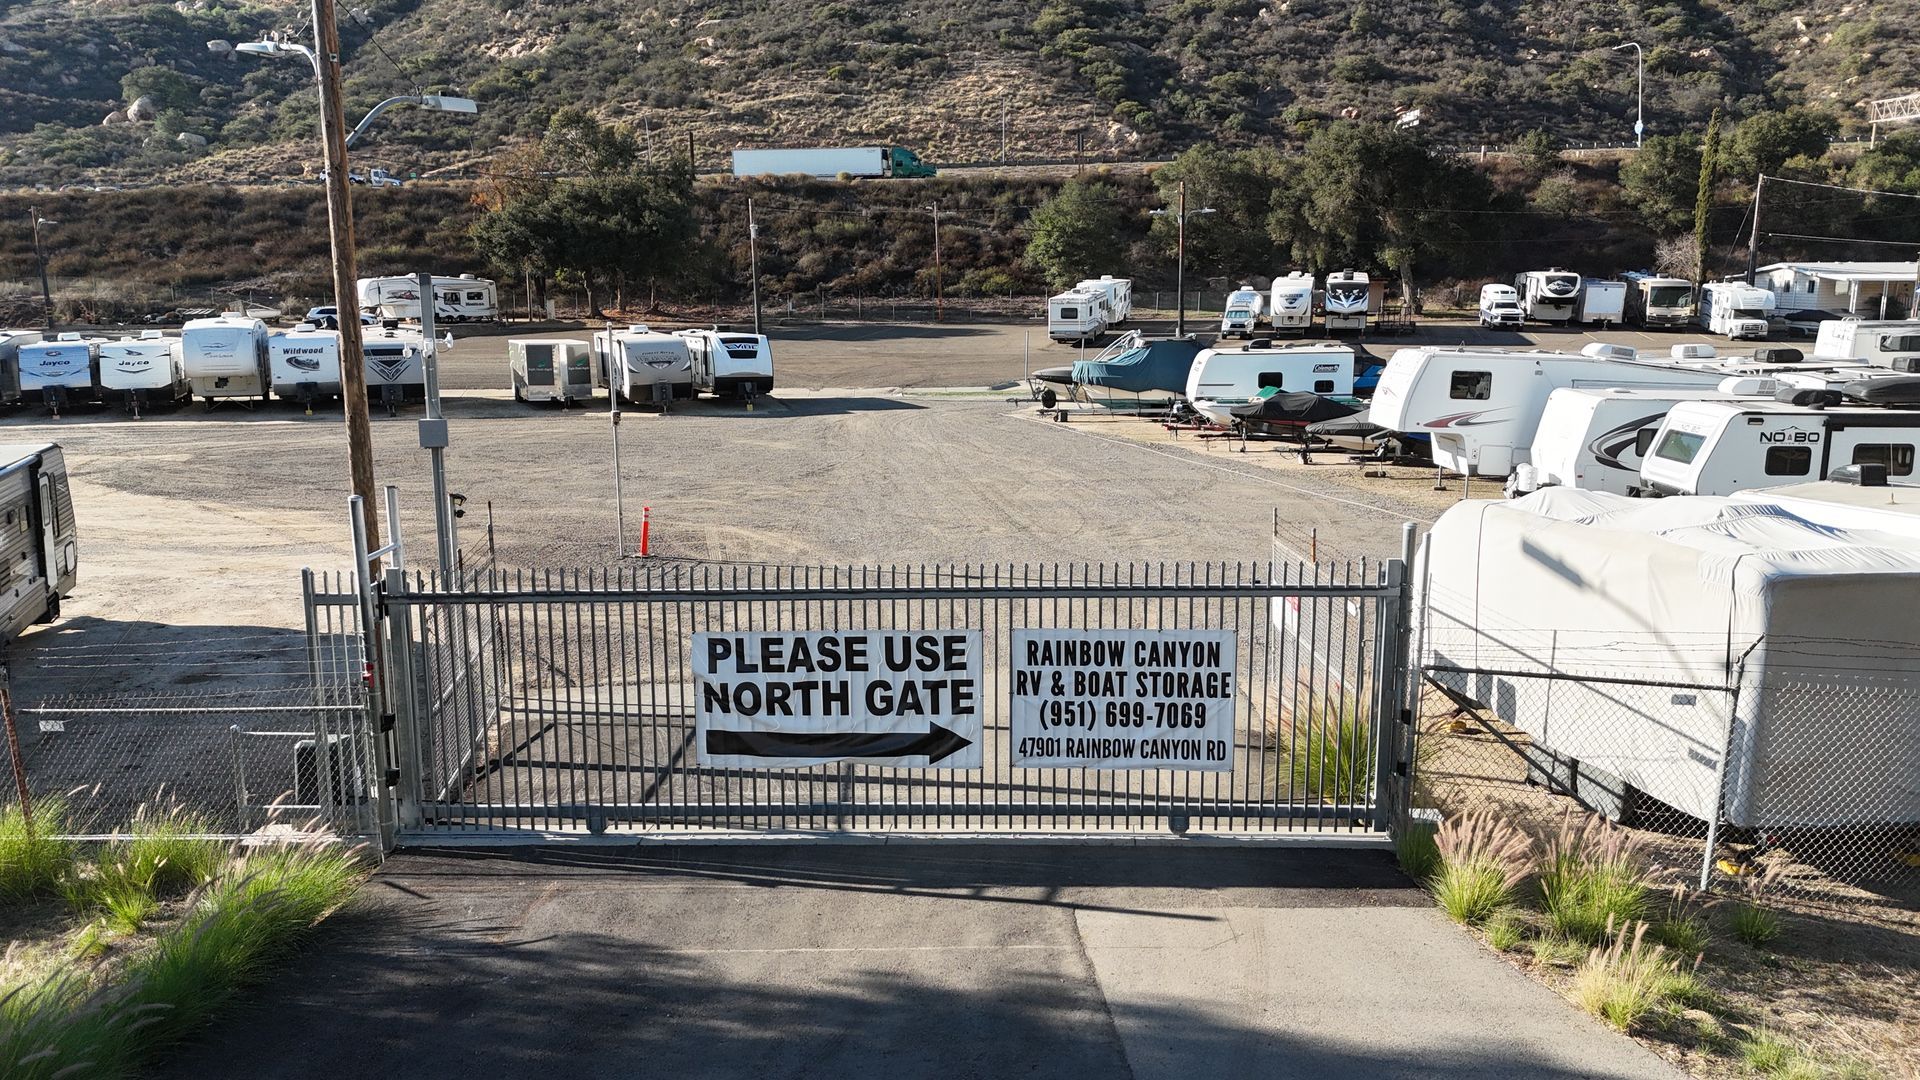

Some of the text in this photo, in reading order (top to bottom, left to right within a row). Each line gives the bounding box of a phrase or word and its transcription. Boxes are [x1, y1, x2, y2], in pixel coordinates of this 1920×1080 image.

[39, 360, 71, 368] Jayco
[118, 360, 150, 368] Jayco
[282, 346, 324, 355] Wildwood
[707, 635, 968, 675] PLEASE USE
[1027, 640, 1221, 668] RAINBOW CANYON
[1016, 669, 1232, 699] RV & BOAT STORAGE
[703, 679, 975, 718] NORTH GATE
[1040, 699, 1206, 731] (951) 699-7069
[1019, 737, 1227, 761] 47901 RAINBOW CANYON RD
